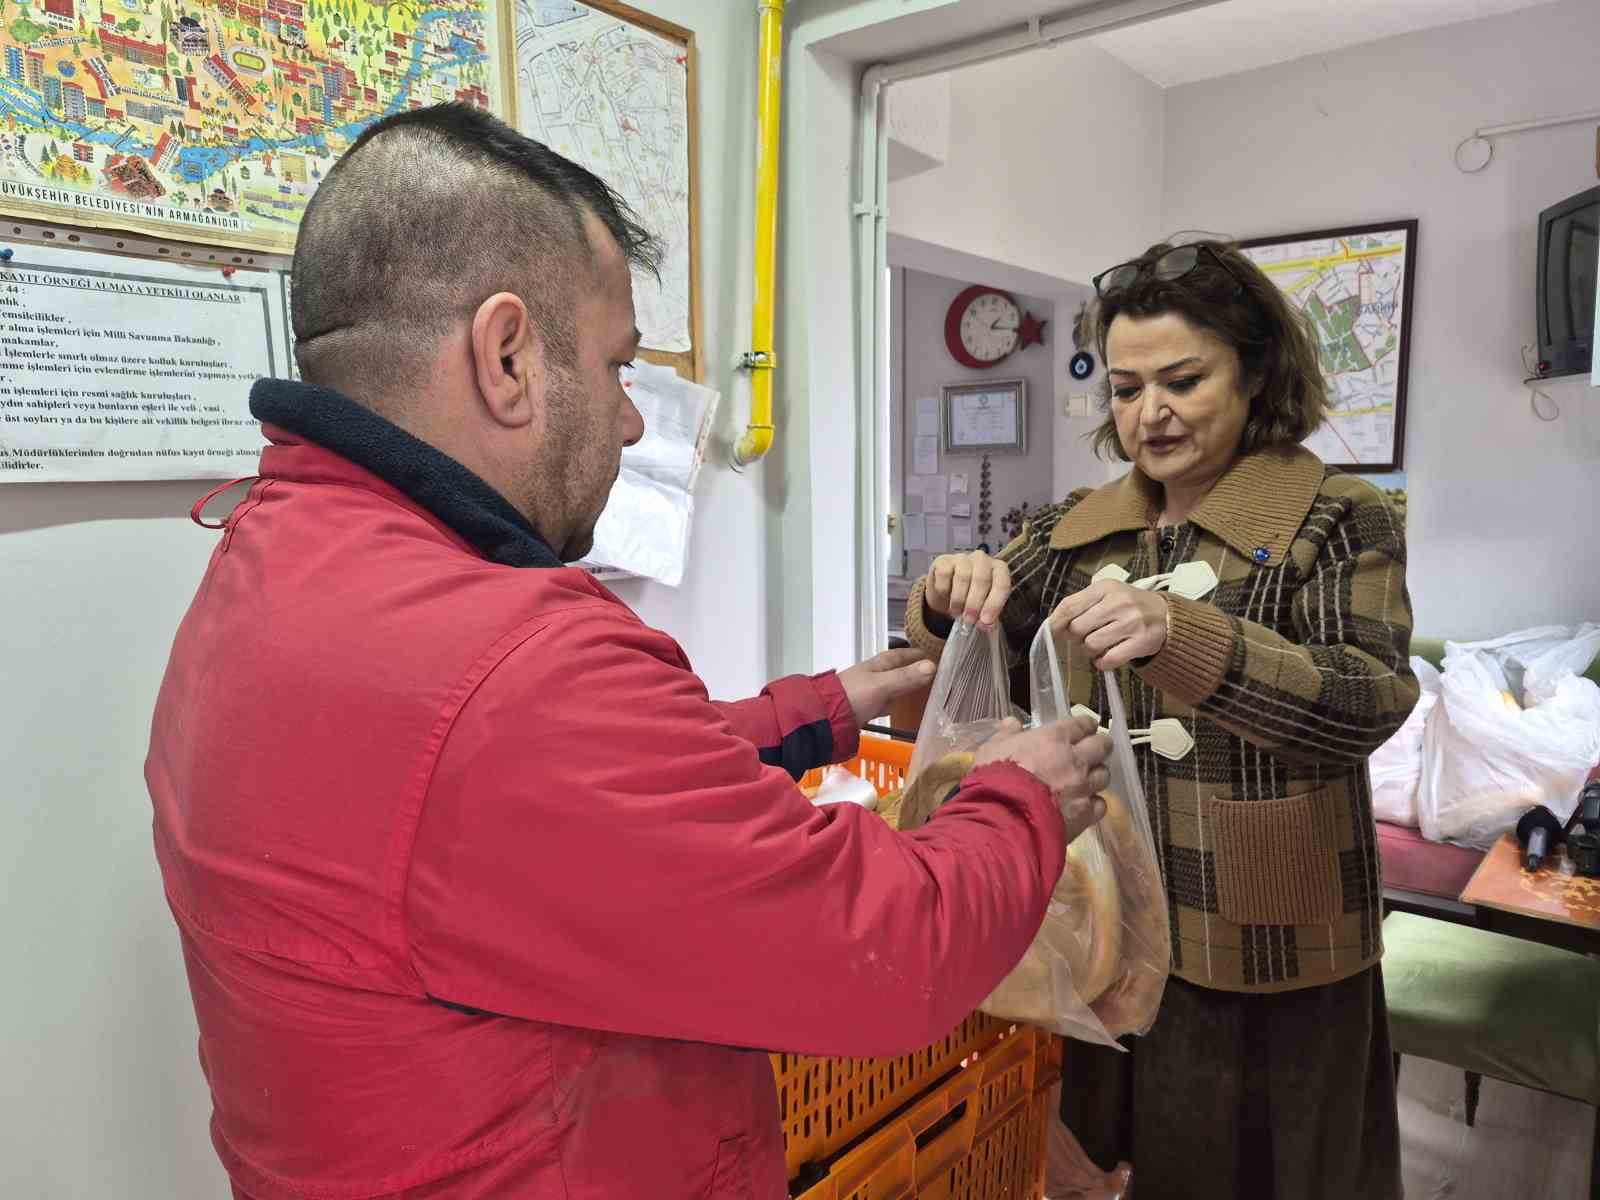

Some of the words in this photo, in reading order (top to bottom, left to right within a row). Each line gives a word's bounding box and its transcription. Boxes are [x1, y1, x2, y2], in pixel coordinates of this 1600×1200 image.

[95, 279, 143, 294] ALMAYA
[192, 291, 240, 303] OLANLAR
[9, 323, 34, 333] alma
[75, 416, 88, 424] da
